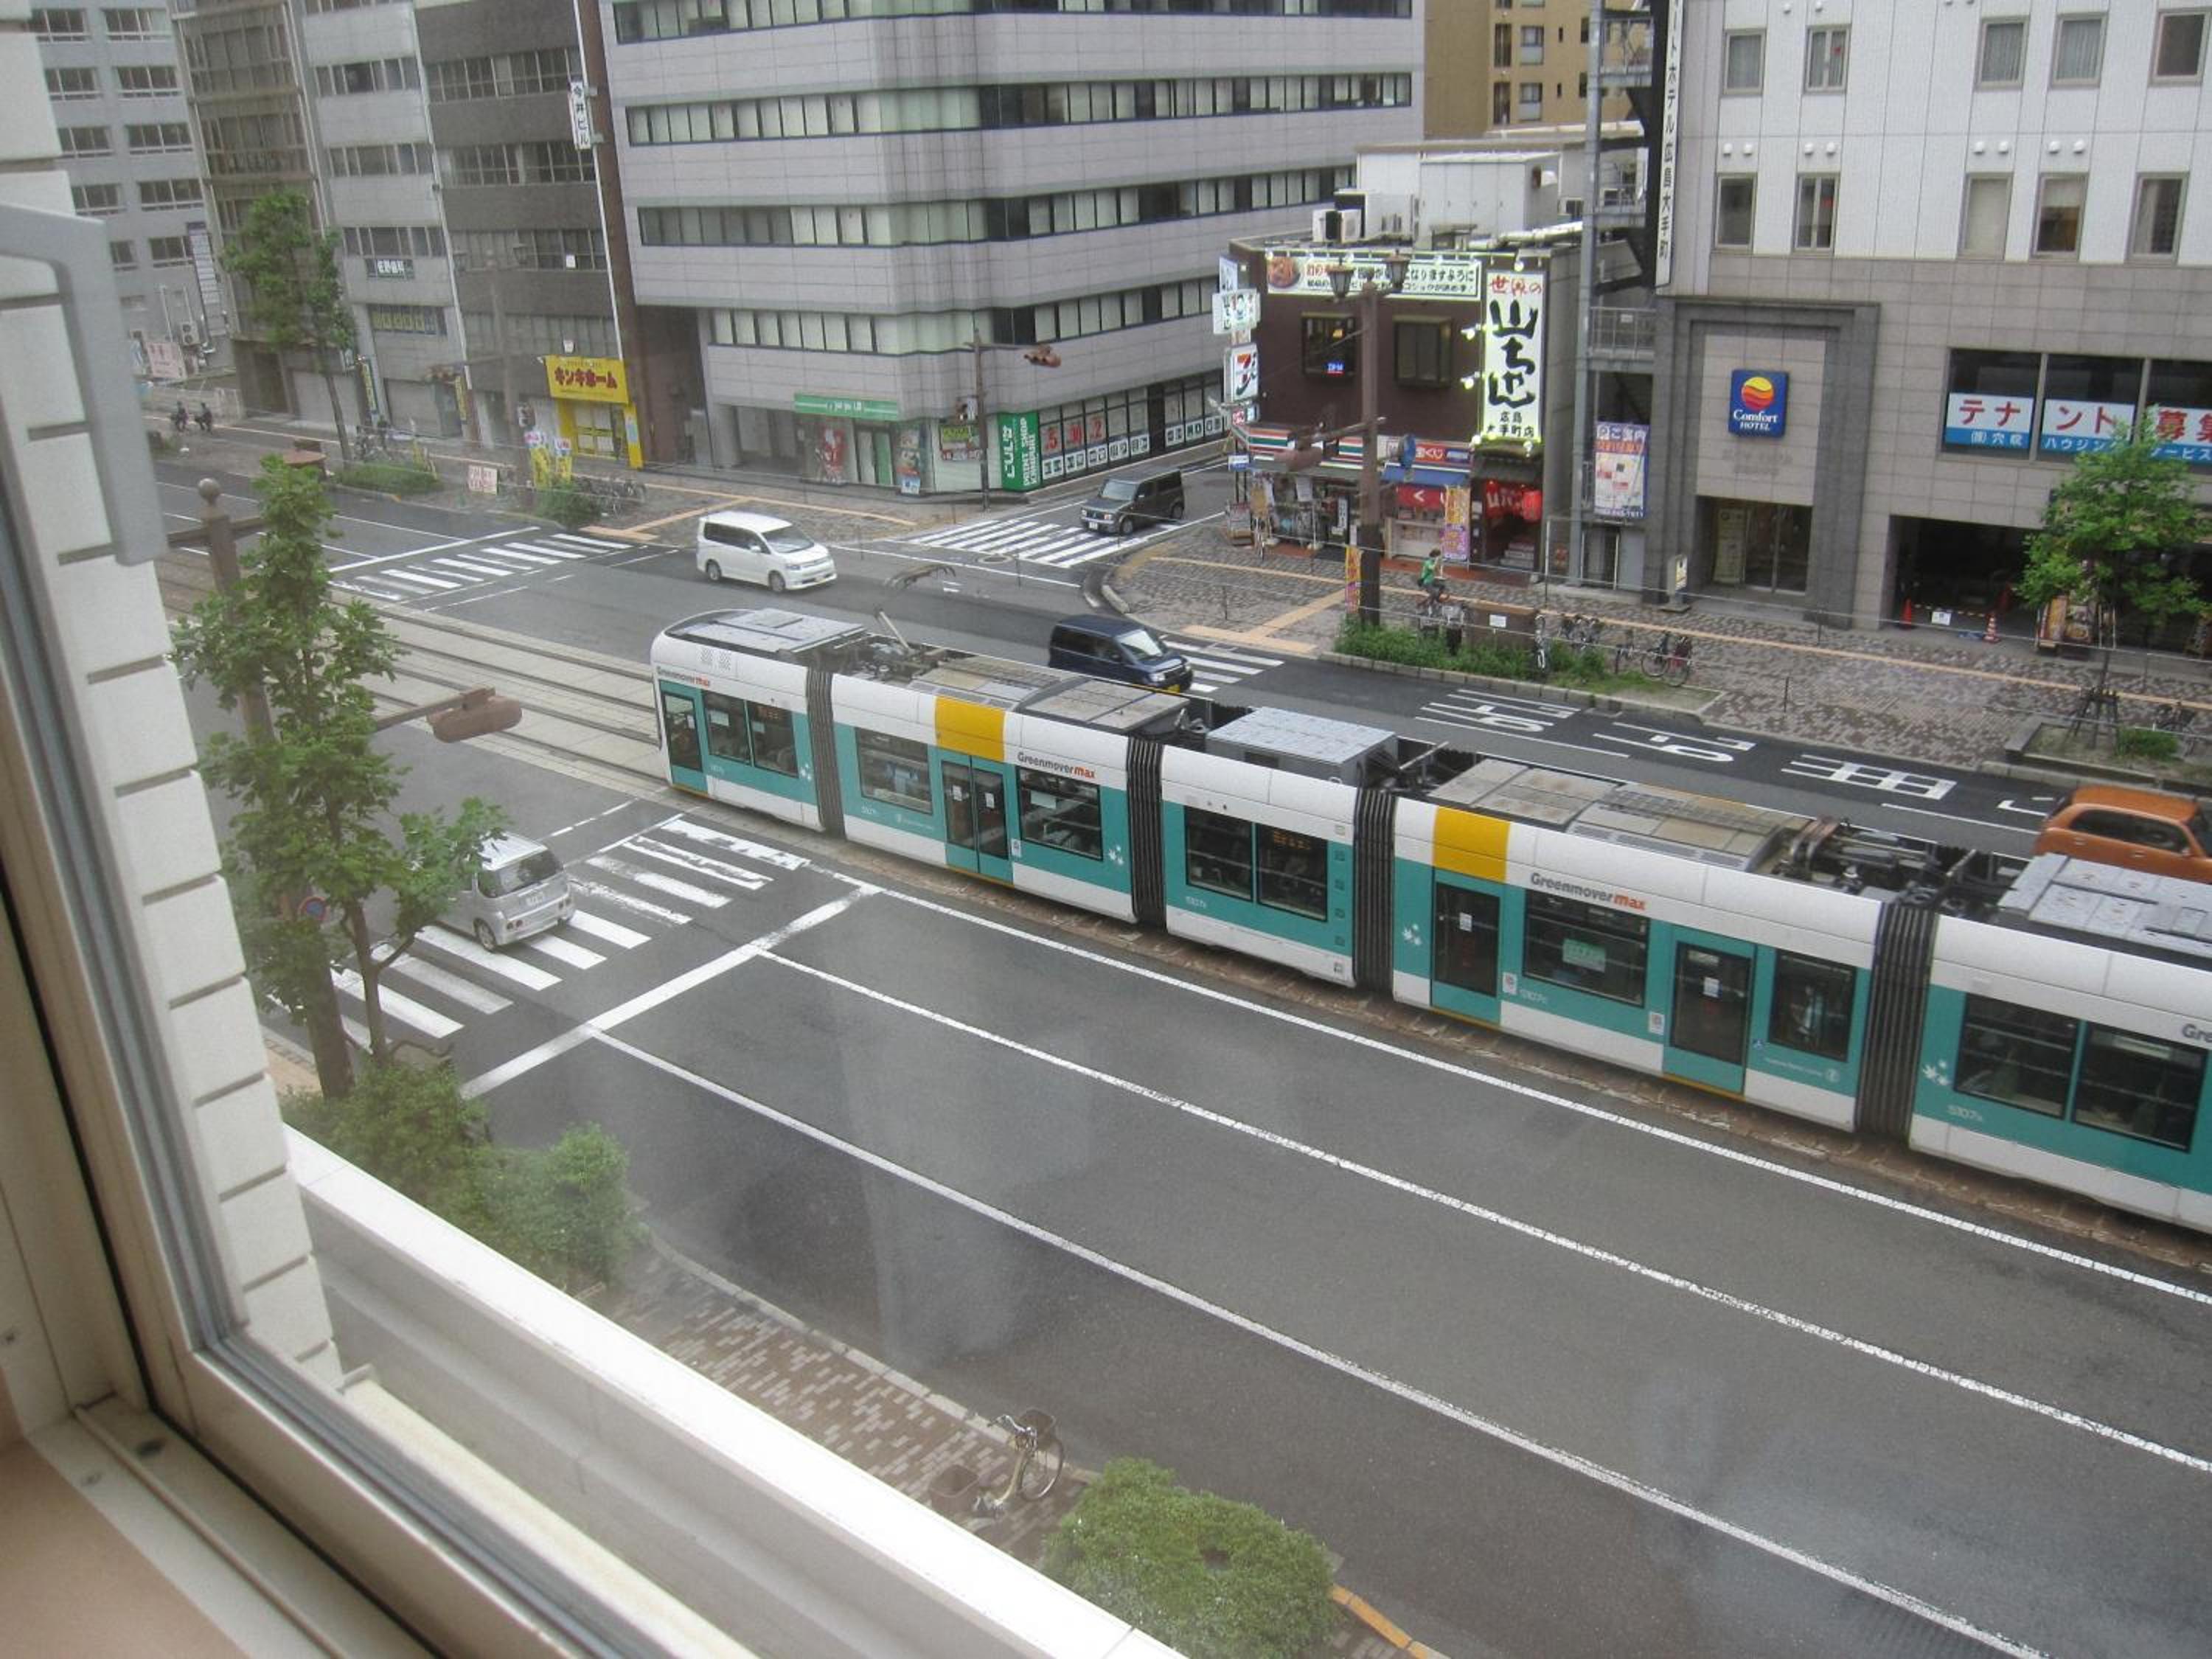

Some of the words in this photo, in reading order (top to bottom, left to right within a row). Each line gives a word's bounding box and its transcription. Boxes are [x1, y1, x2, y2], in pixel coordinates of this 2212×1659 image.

[573, 86, 589, 145] 今井ビル
[1491, 275, 1542, 296] 世界の
[554, 366, 618, 389] キンキホーム
[1733, 408, 1778, 423] Comfort
[1739, 421, 1771, 431] HOTEL
[1020, 417, 1029, 448] SHOP
